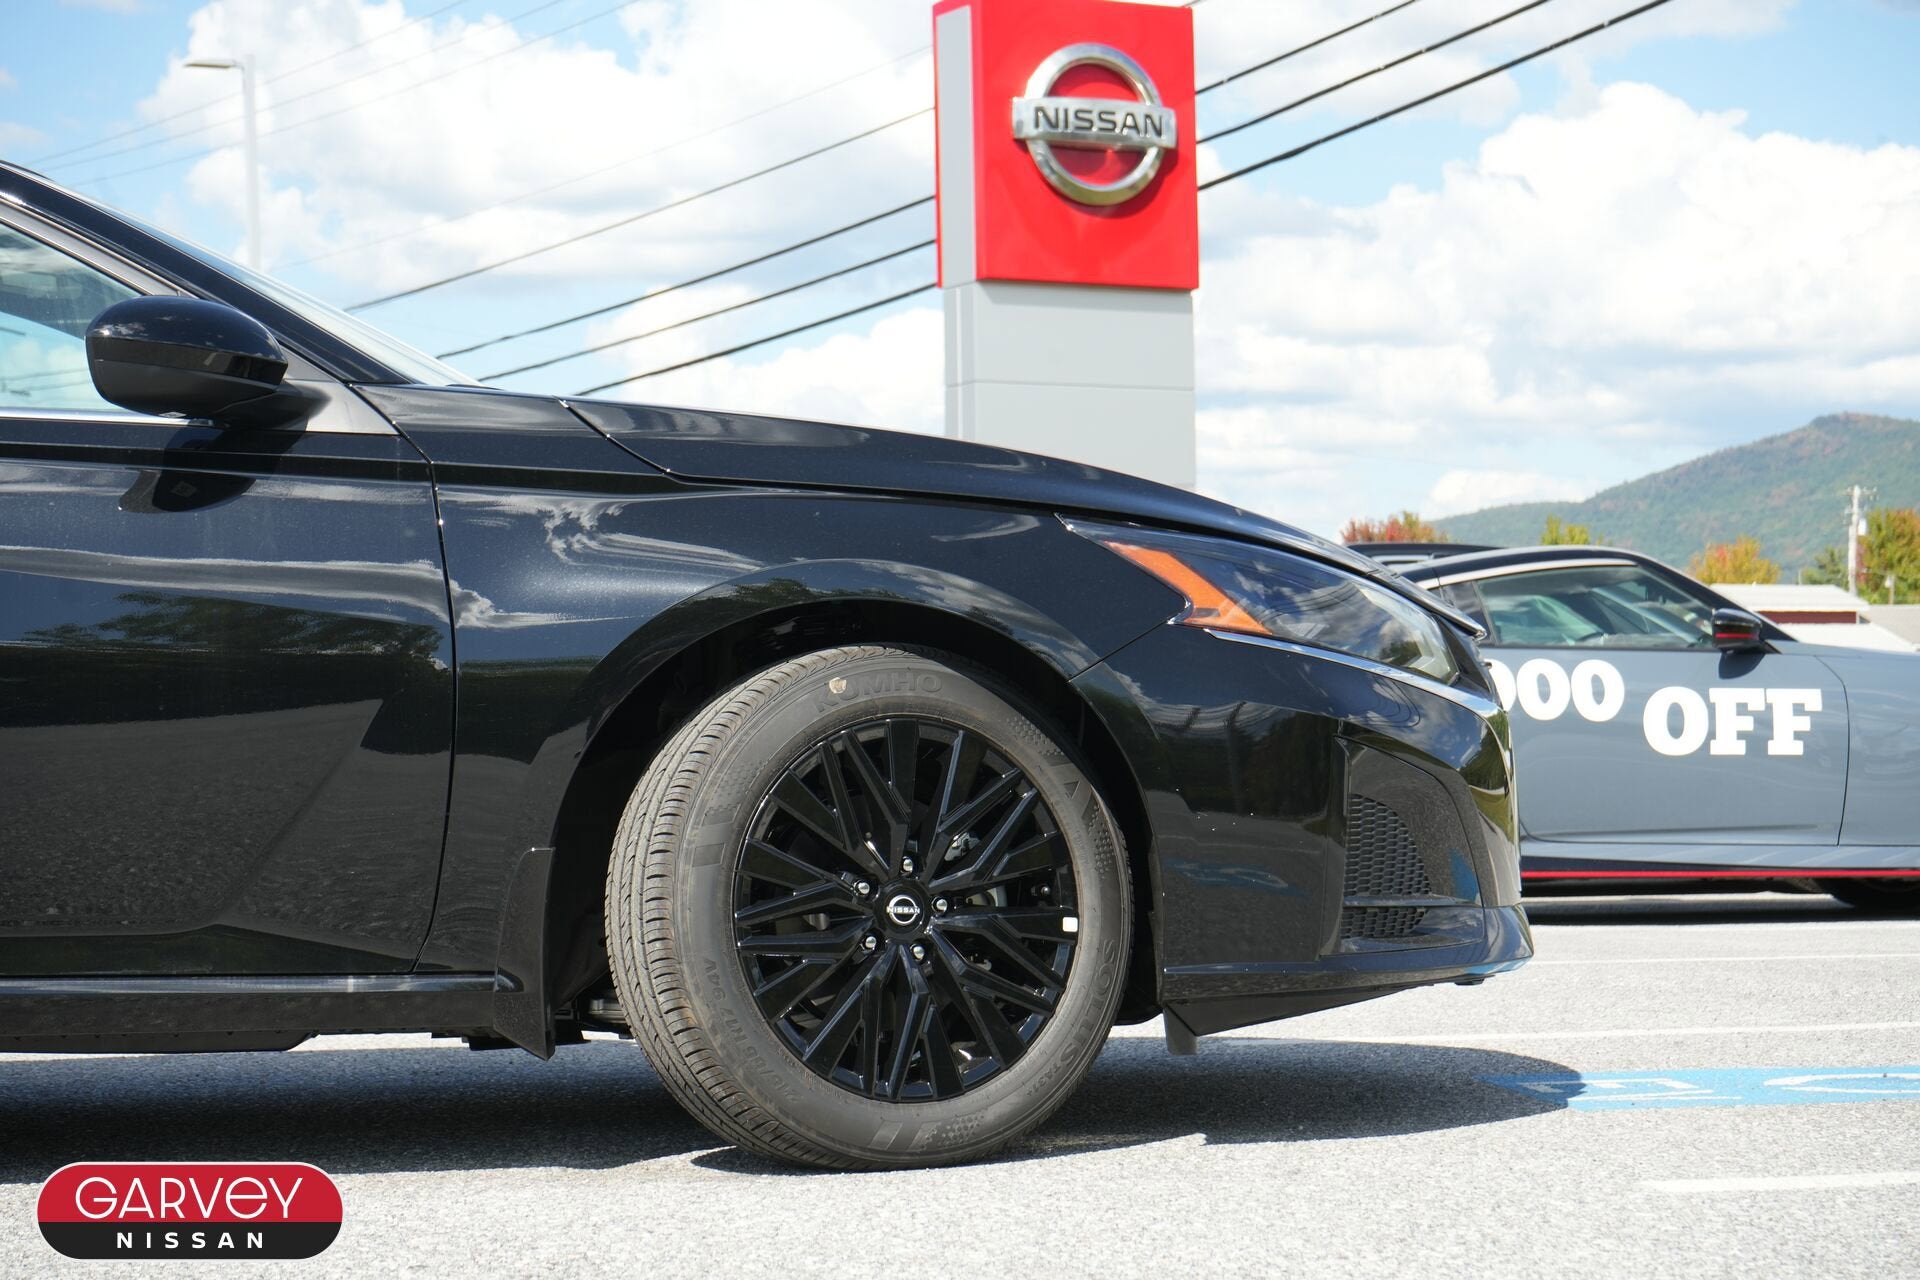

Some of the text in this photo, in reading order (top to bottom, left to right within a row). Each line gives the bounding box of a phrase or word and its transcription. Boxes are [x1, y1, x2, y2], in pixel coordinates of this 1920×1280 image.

[1033, 106, 1164, 138] NISSAN
[1643, 686, 1822, 756] OFF
[886, 905, 921, 914] NISSAN
